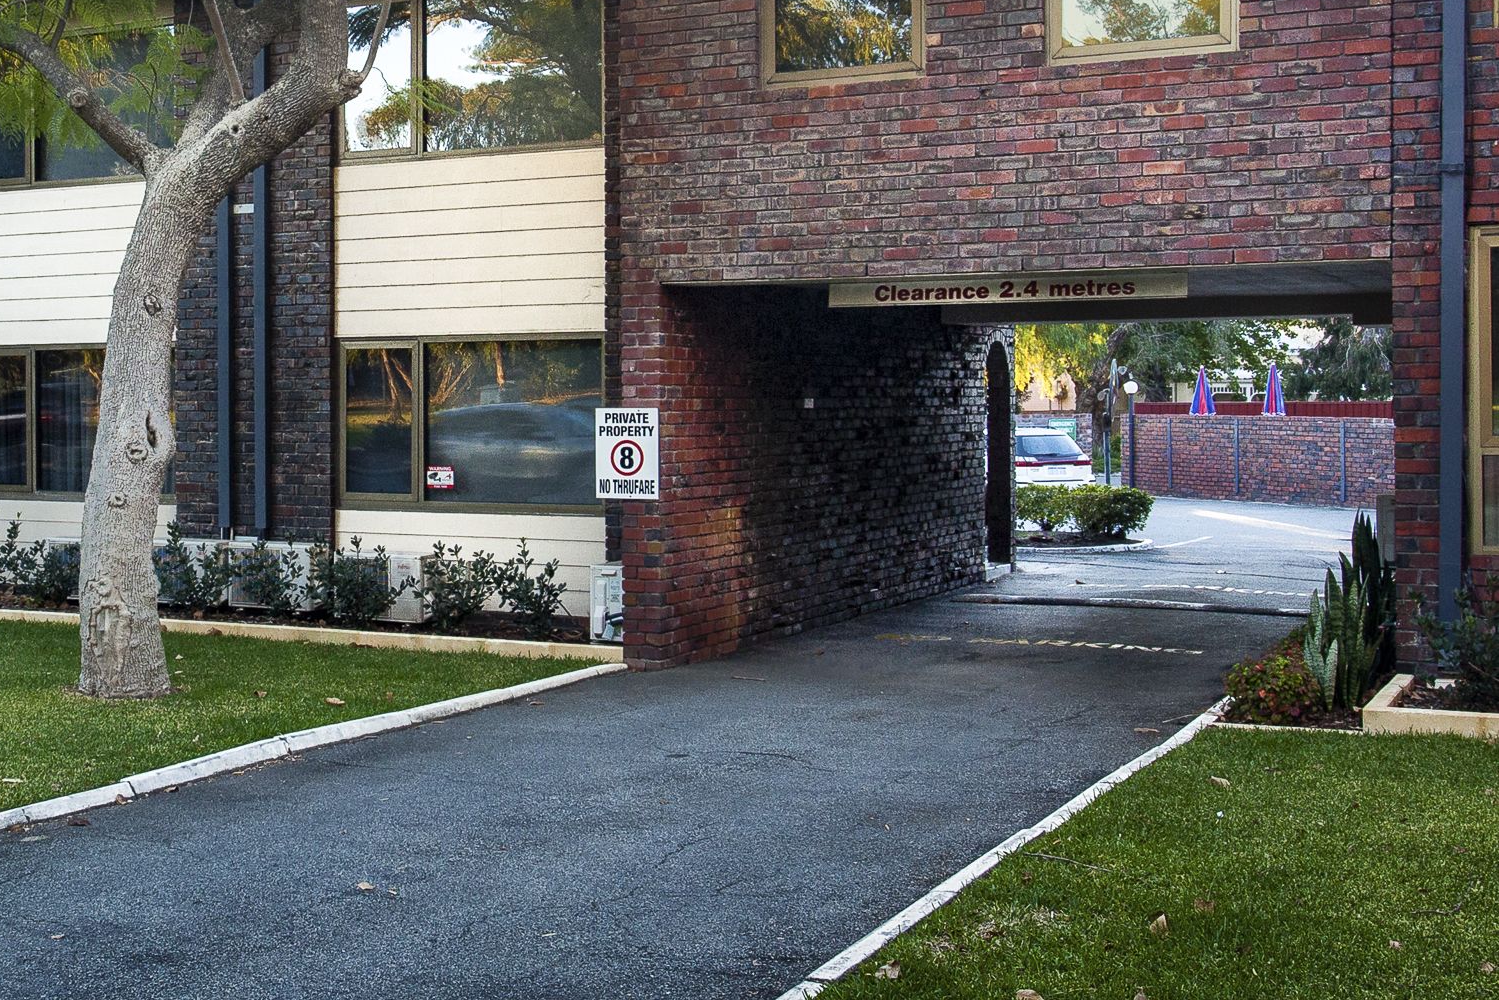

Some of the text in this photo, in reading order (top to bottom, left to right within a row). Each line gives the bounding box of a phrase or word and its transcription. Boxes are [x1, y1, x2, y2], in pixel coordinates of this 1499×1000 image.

[874, 280, 1136, 301] Clearance 2.4 metres
[604, 412, 649, 424] PRIVATE
[599, 425, 654, 437] PROPERTY
[619, 446, 634, 469] 8
[599, 478, 655, 495] NO THRUFARE
